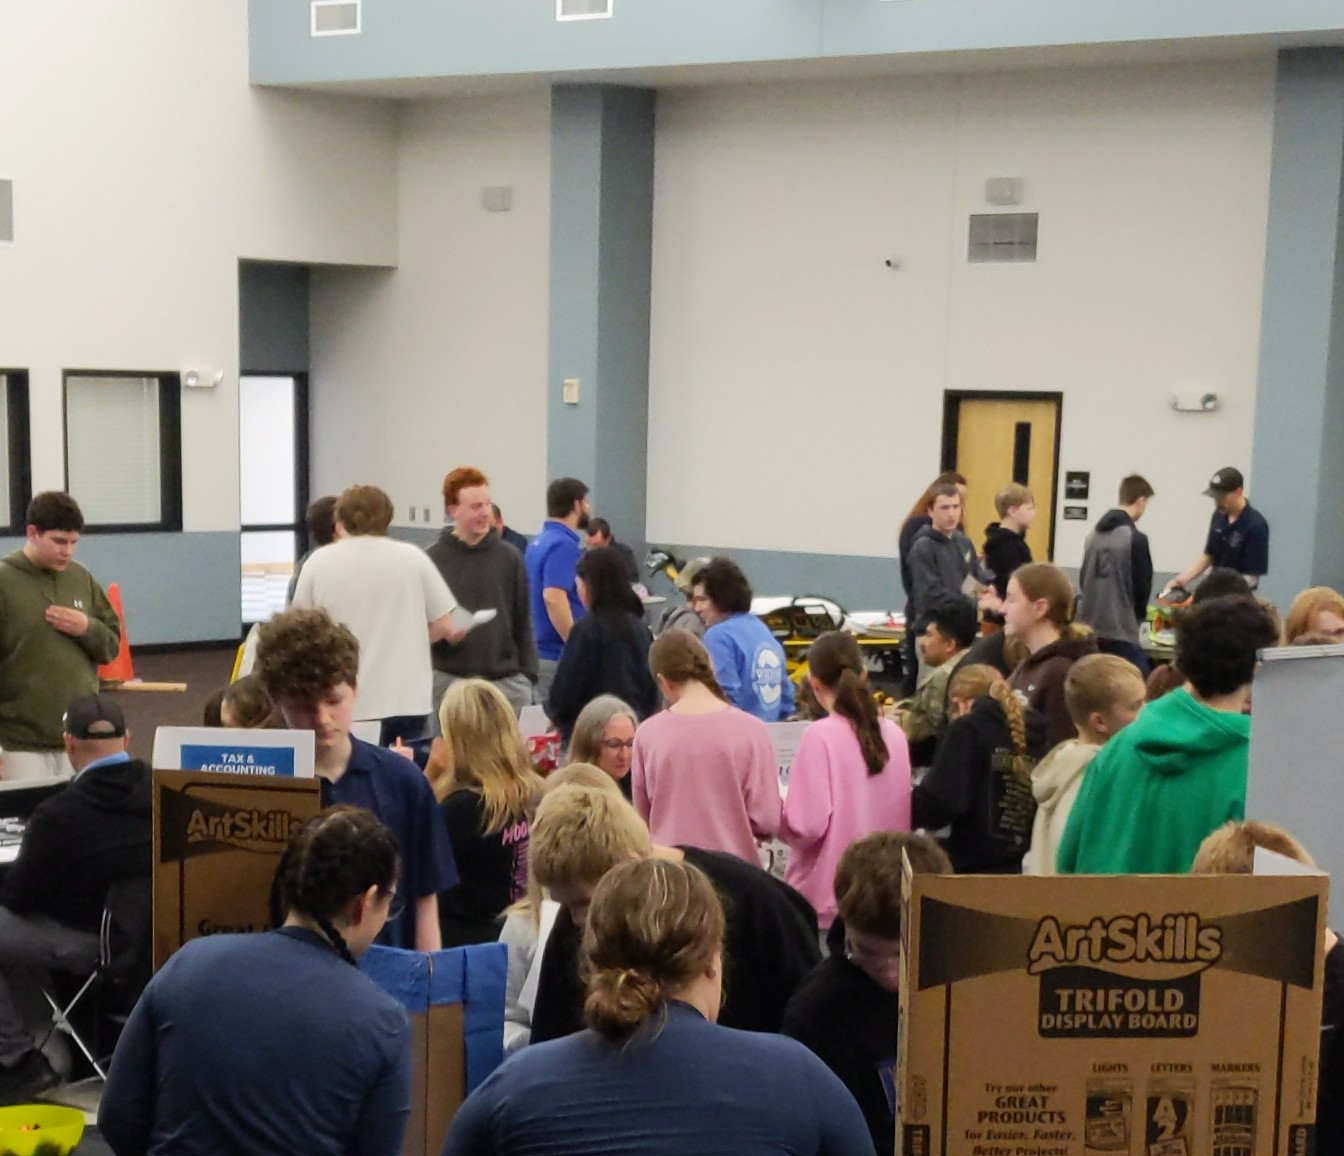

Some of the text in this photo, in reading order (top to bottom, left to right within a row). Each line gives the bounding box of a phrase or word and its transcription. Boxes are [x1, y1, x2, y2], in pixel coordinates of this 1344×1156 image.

[221, 753, 244, 764] TAX
[200, 763, 276, 776] ACCOUNTING
[1028, 912, 1223, 963] ArtSkills
[1054, 988, 1185, 1013] TRIFOLD
[1041, 1013, 1197, 1030] DISPLAY BOARD
[1092, 1063, 1261, 1073] LIGHTS LETTERS MARKERS
[985, 1083, 1057, 1094] Try our other
[995, 1095, 1050, 1109] GREAT
[977, 1110, 1067, 1124] PRODUCTS
[965, 1129, 983, 1140] for
[972, 1145, 1012, 1156] Better
